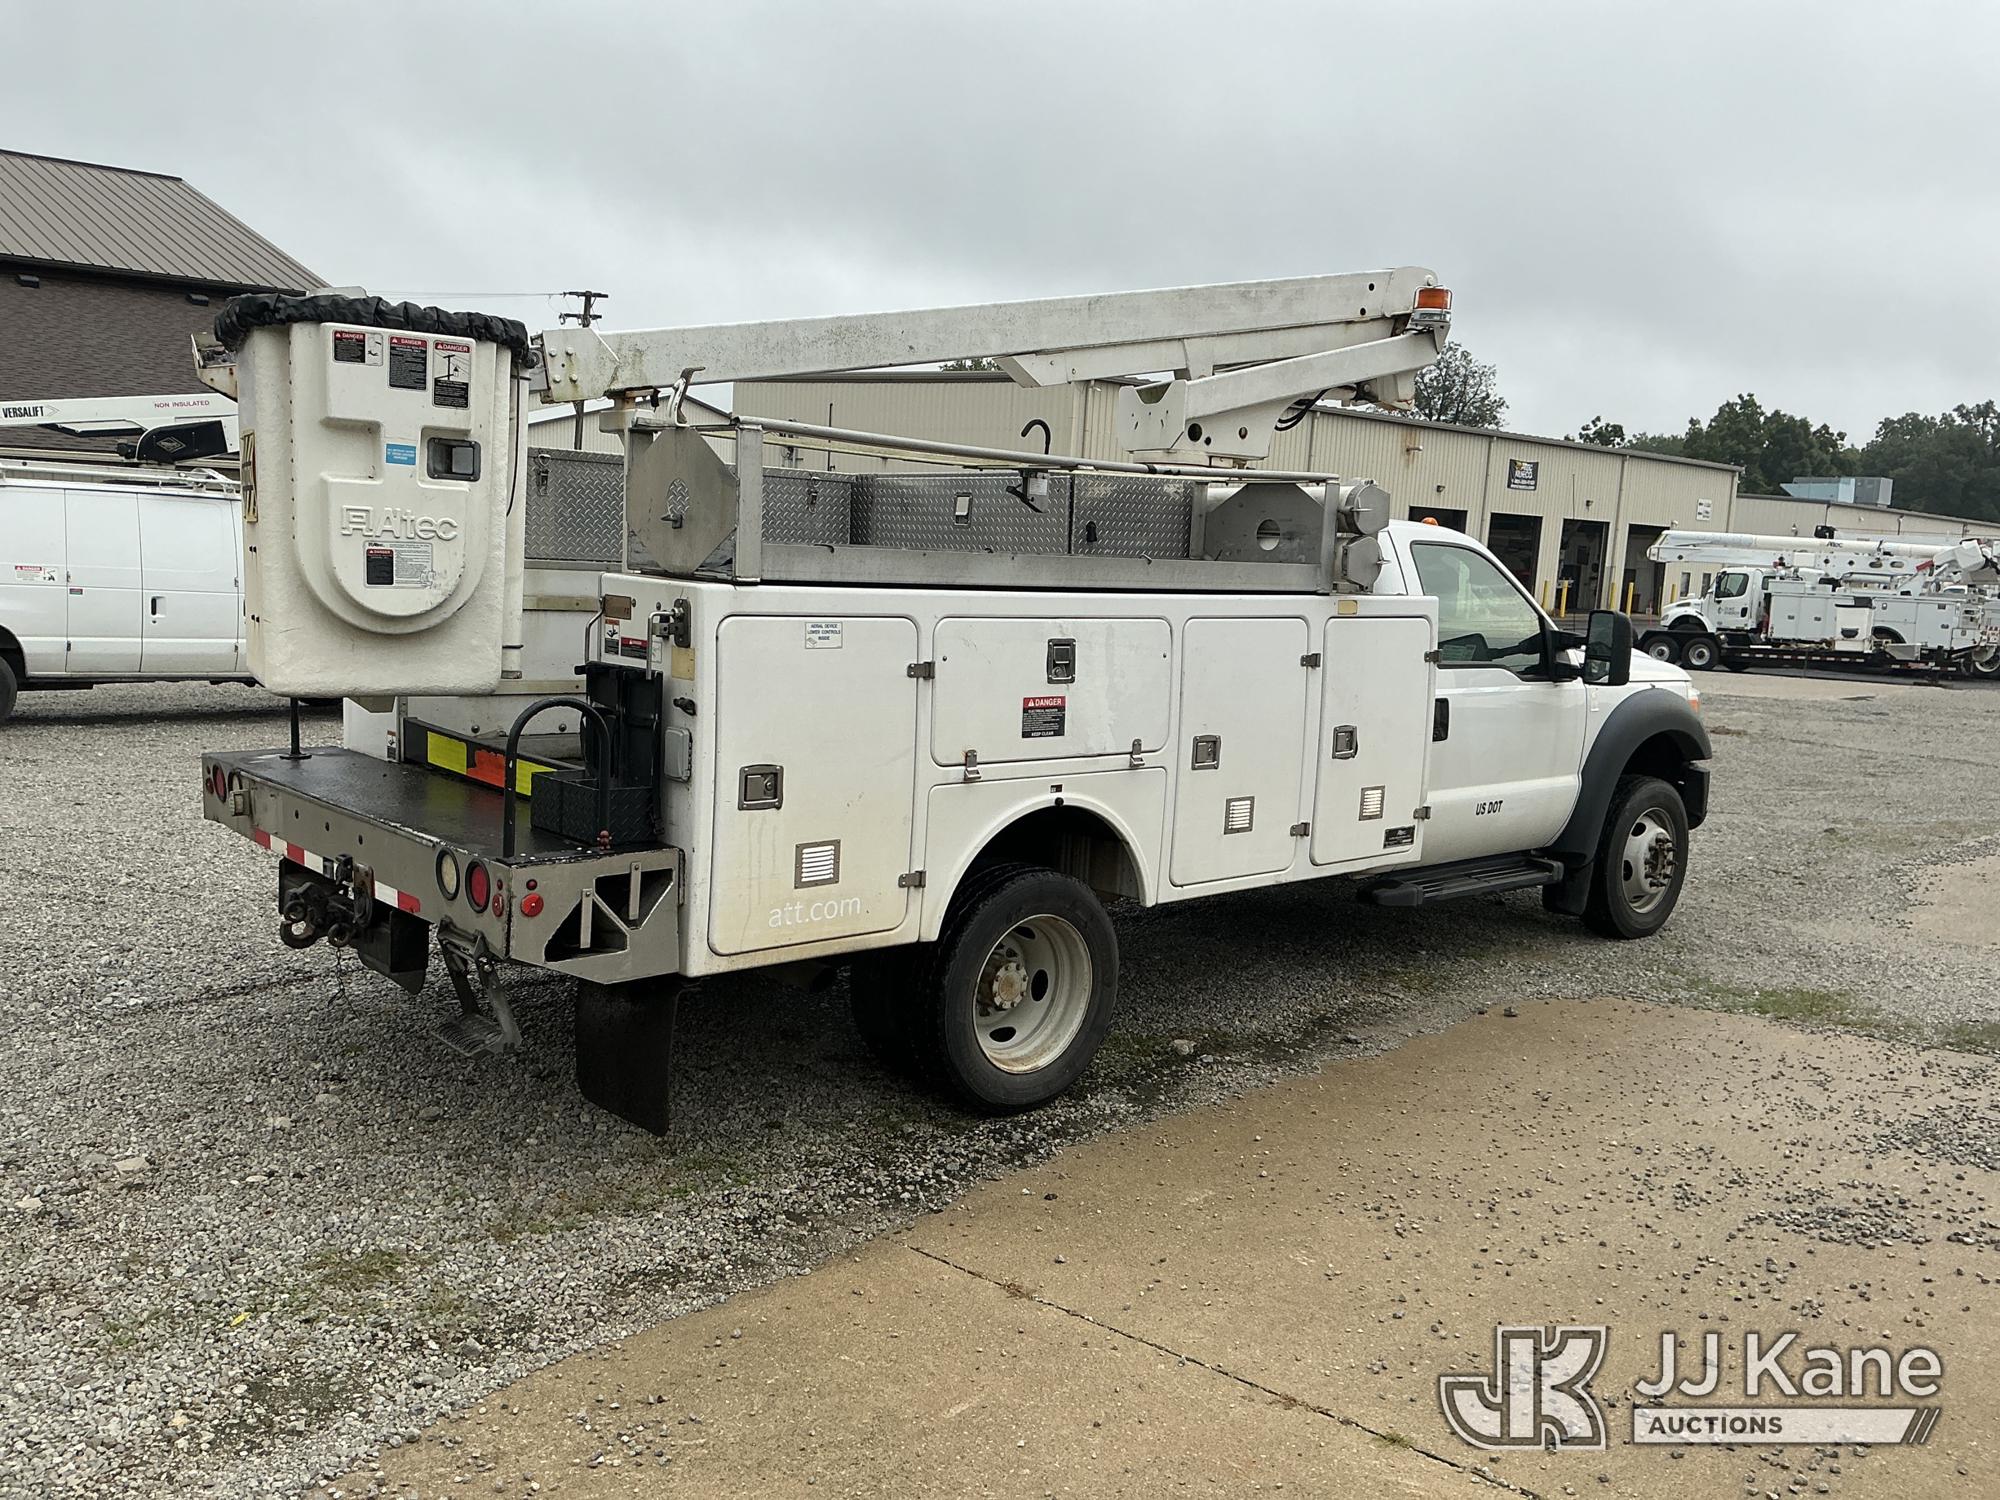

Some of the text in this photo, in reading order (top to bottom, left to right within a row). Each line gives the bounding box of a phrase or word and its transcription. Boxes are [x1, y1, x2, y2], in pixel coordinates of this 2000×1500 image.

[442, 344, 469, 352] DANGER
[2, 406, 44, 418] VERSALIFT
[374, 506, 458, 541] Altec
[1035, 698, 1062, 706] DANGER
[1476, 800, 1503, 816] US DOT
[768, 897, 861, 928] att.com
